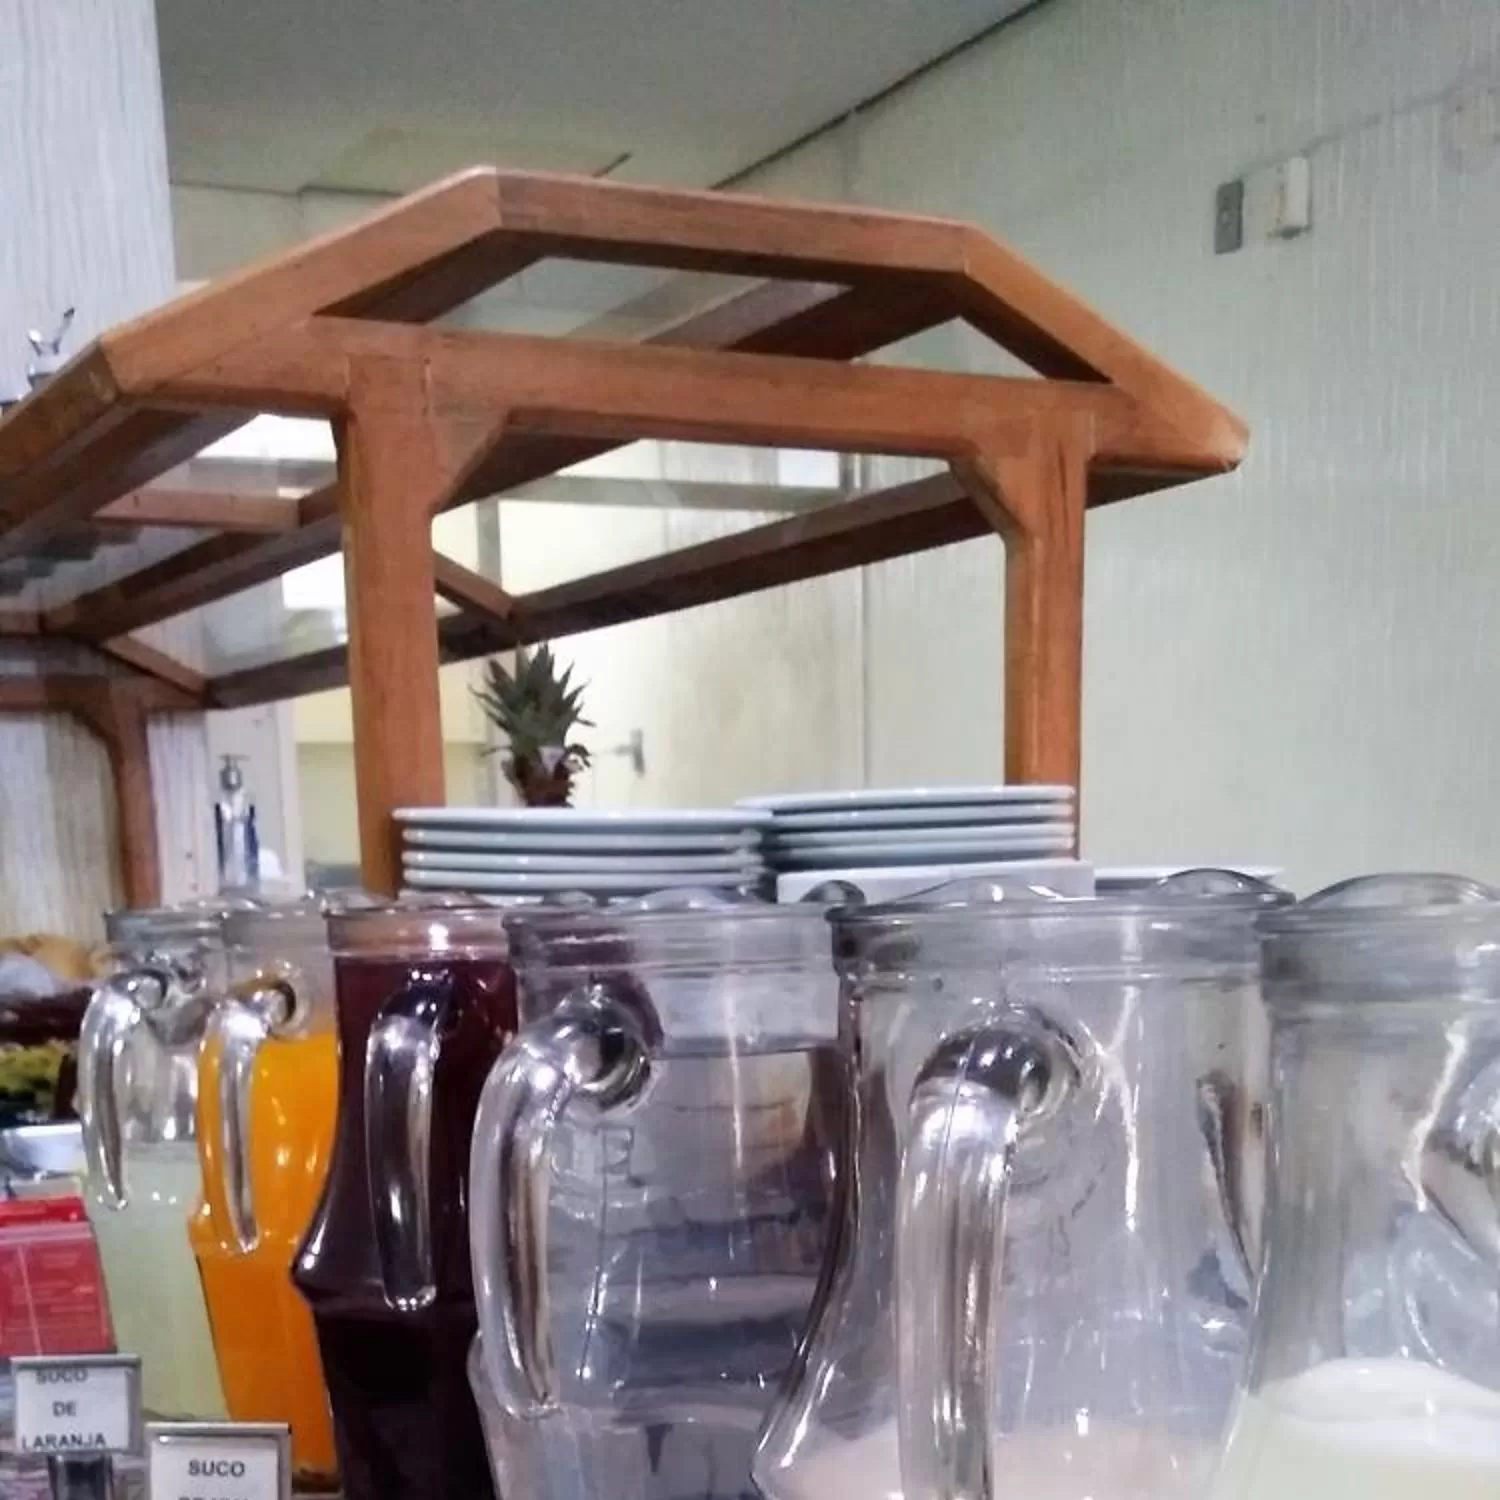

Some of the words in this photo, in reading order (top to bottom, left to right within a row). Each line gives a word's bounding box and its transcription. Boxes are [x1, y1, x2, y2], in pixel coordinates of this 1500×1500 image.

[35, 1368, 88, 1384] SUCO
[52, 1401, 77, 1417] DE
[21, 1431, 107, 1450] LARANJA
[187, 1460, 246, 1478] SUCO
